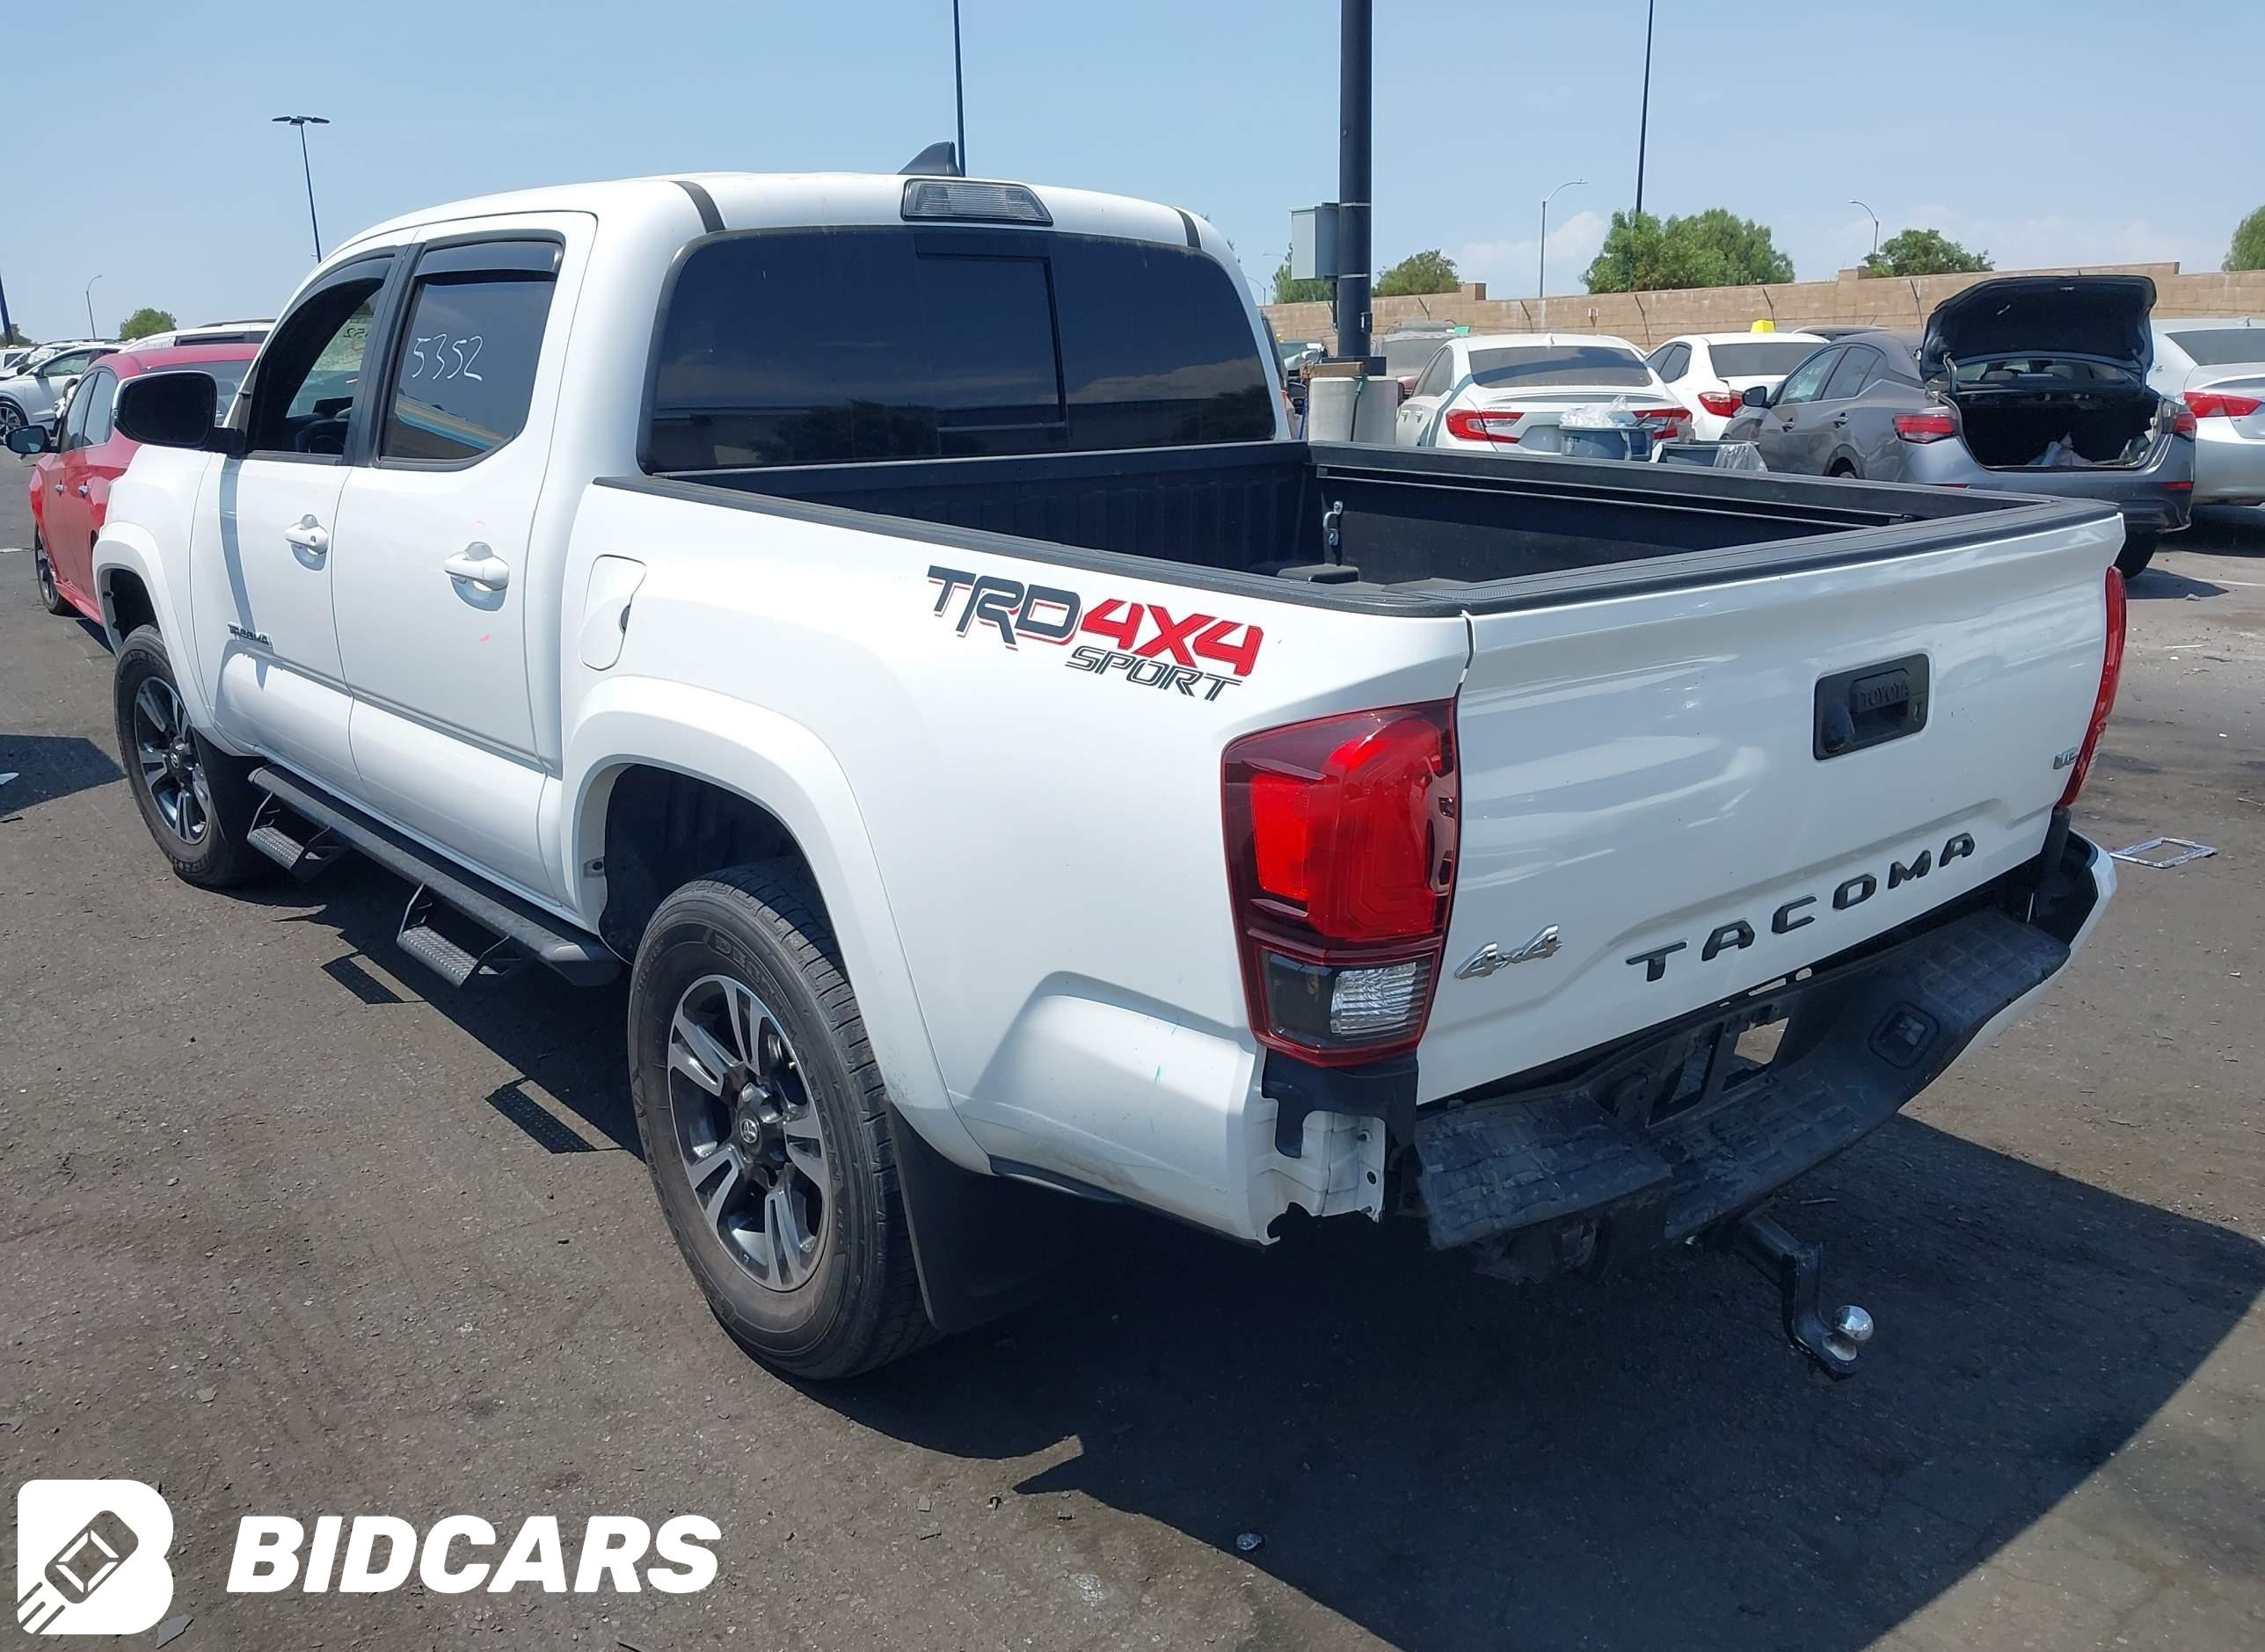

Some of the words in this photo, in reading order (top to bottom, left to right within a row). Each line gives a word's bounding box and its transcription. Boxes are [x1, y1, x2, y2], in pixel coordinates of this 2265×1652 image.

[411, 333, 483, 381] 5352
[927, 564, 1082, 651] TRD
[1064, 645, 1243, 702] SPORT
[1858, 680, 1909, 709] TOYOTA
[1625, 832, 1976, 983] TACOMA
